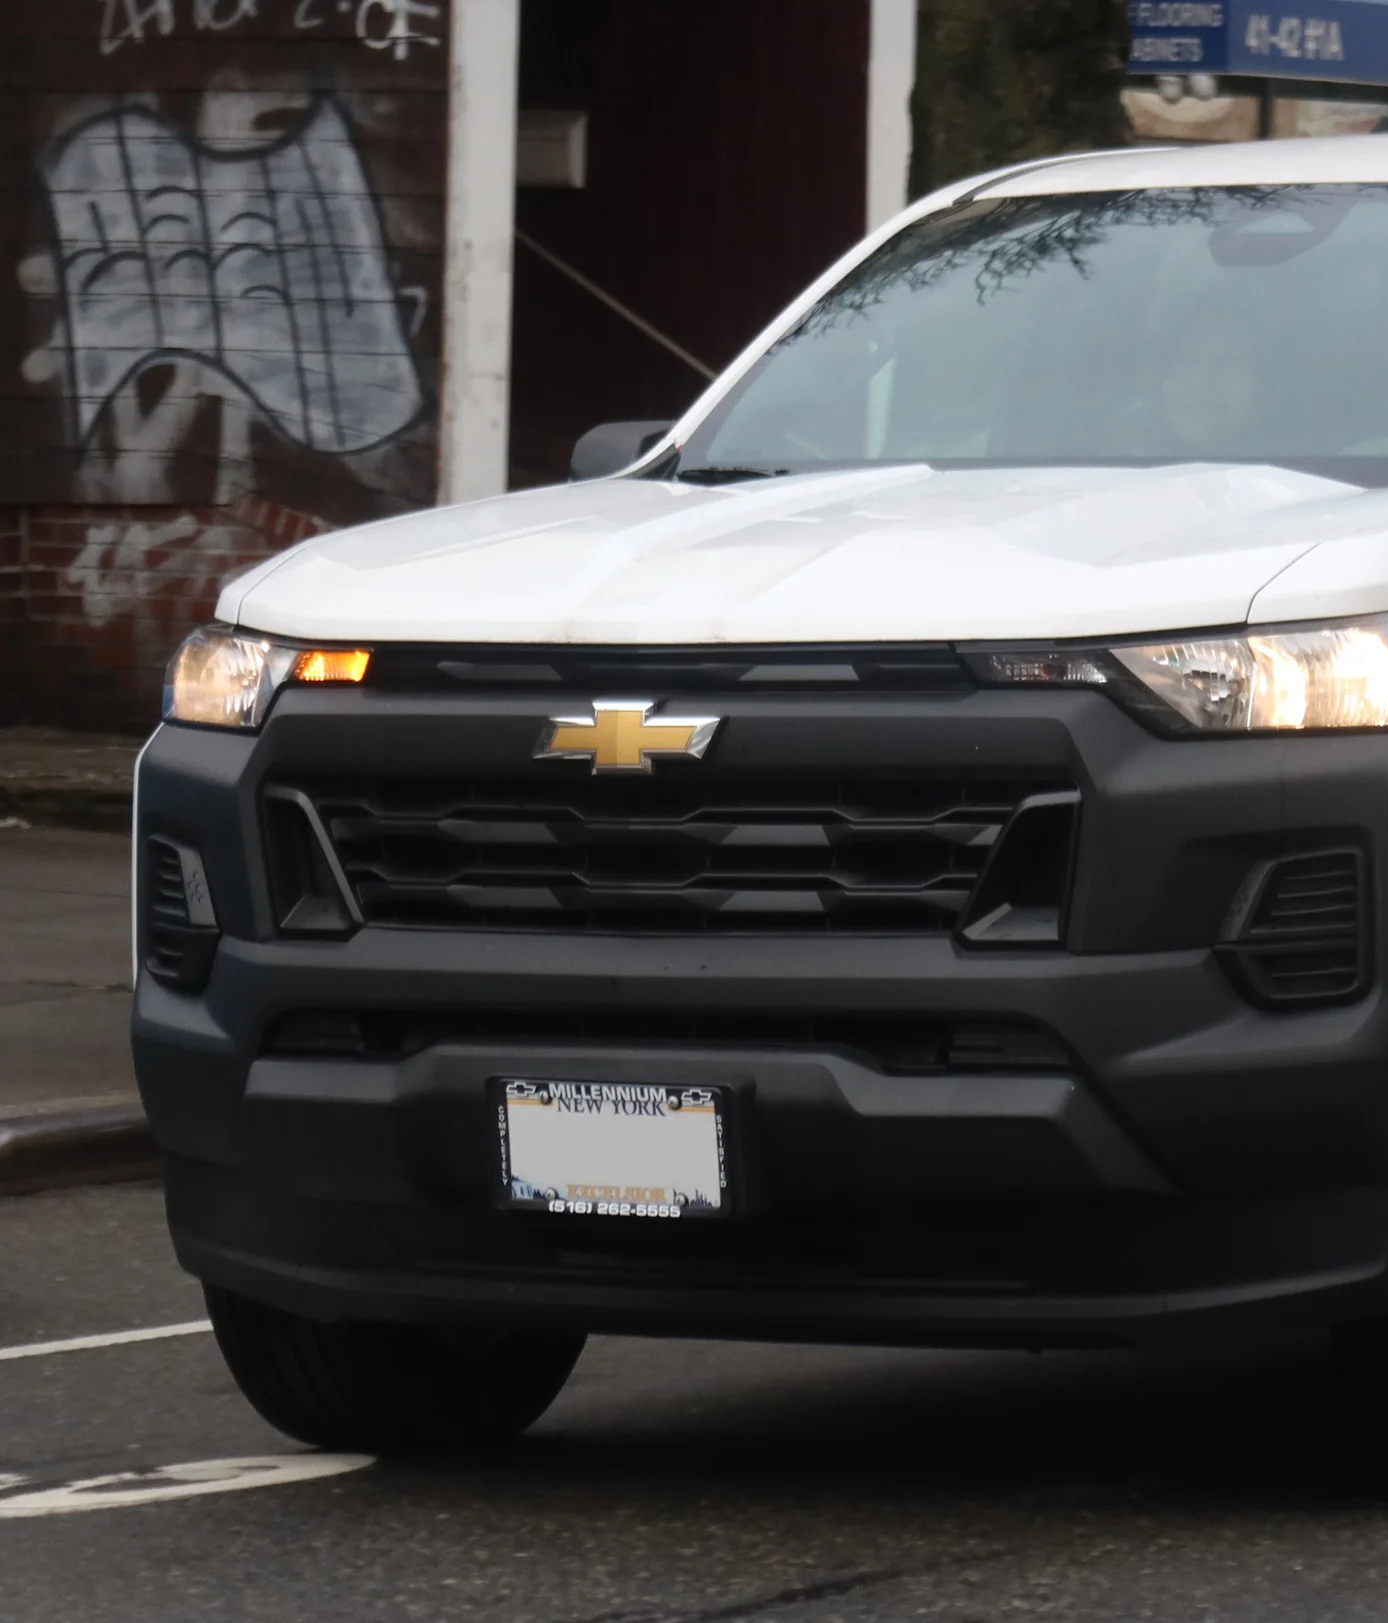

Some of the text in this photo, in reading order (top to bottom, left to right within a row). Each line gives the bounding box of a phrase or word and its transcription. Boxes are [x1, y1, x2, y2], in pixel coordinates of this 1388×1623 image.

[1129, 37, 1203, 62] ABINETS
[548, 1083, 667, 1102] MILLENNIUM
[556, 1099, 667, 1118] NEW YORK
[548, 1200, 593, 1215] (516)
